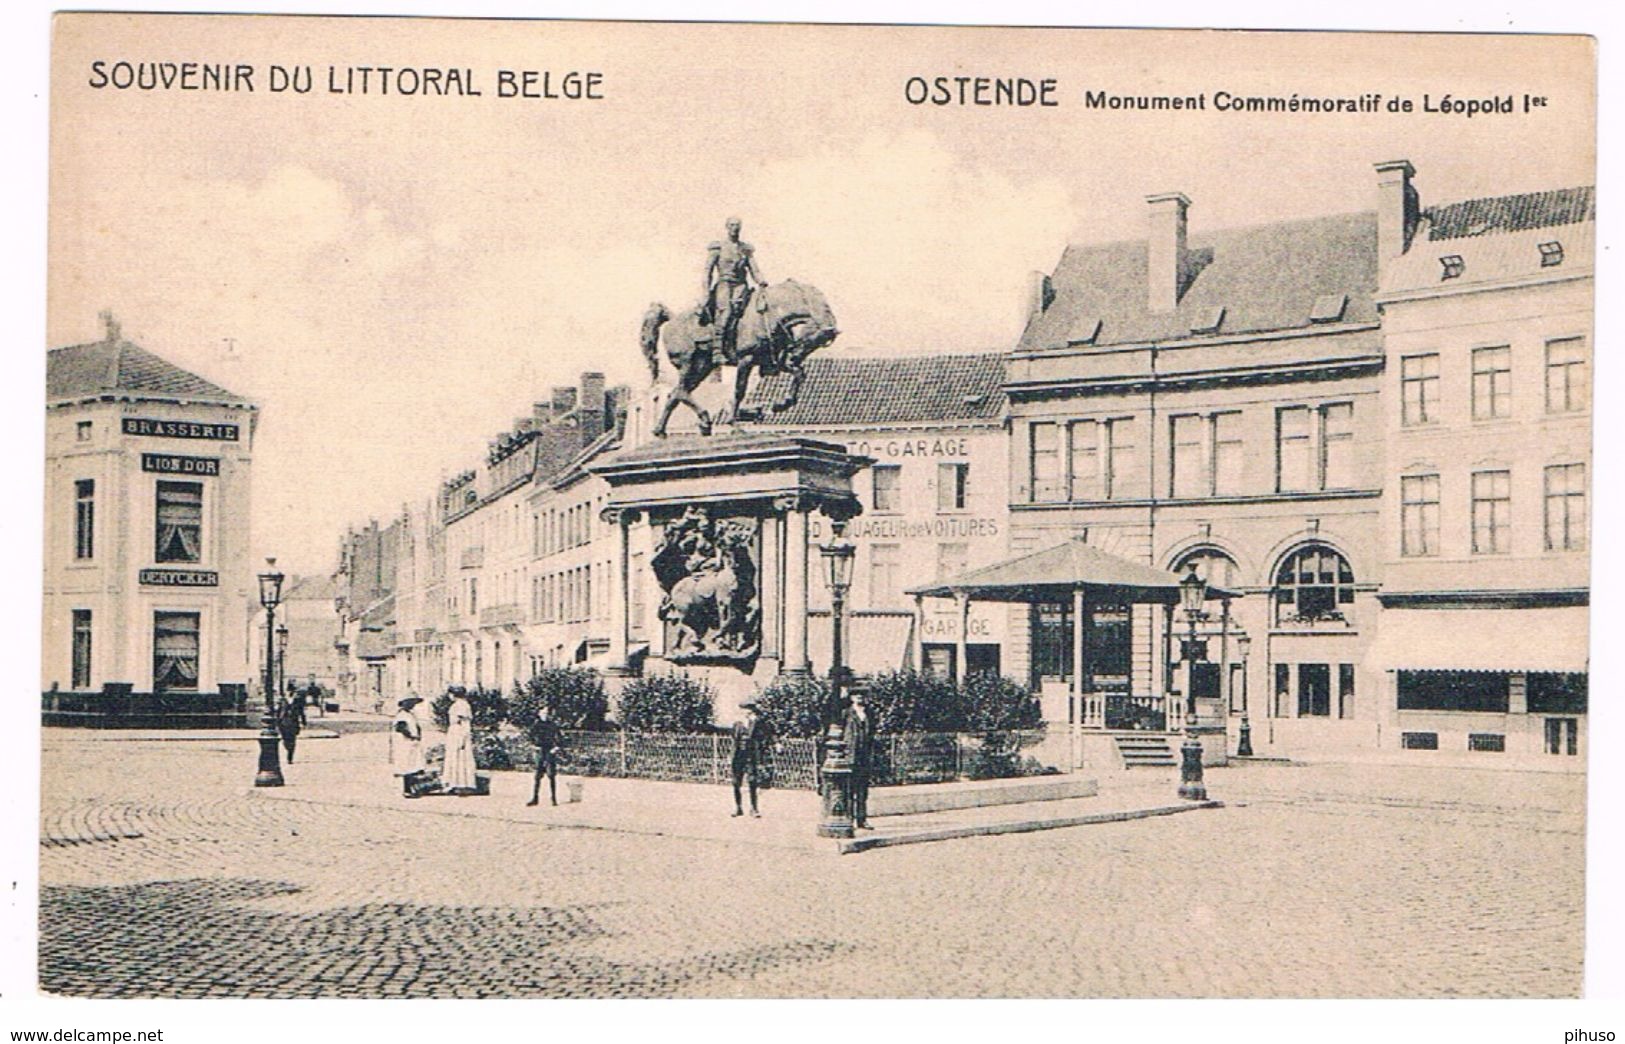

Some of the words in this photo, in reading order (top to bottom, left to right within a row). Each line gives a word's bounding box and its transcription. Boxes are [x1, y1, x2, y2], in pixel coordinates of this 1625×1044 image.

[126, 421, 235, 439] BRASSERIE
[846, 438, 970, 457] TO-GARAGE
[145, 457, 181, 471] LION
[923, 619, 990, 636] GARGE
